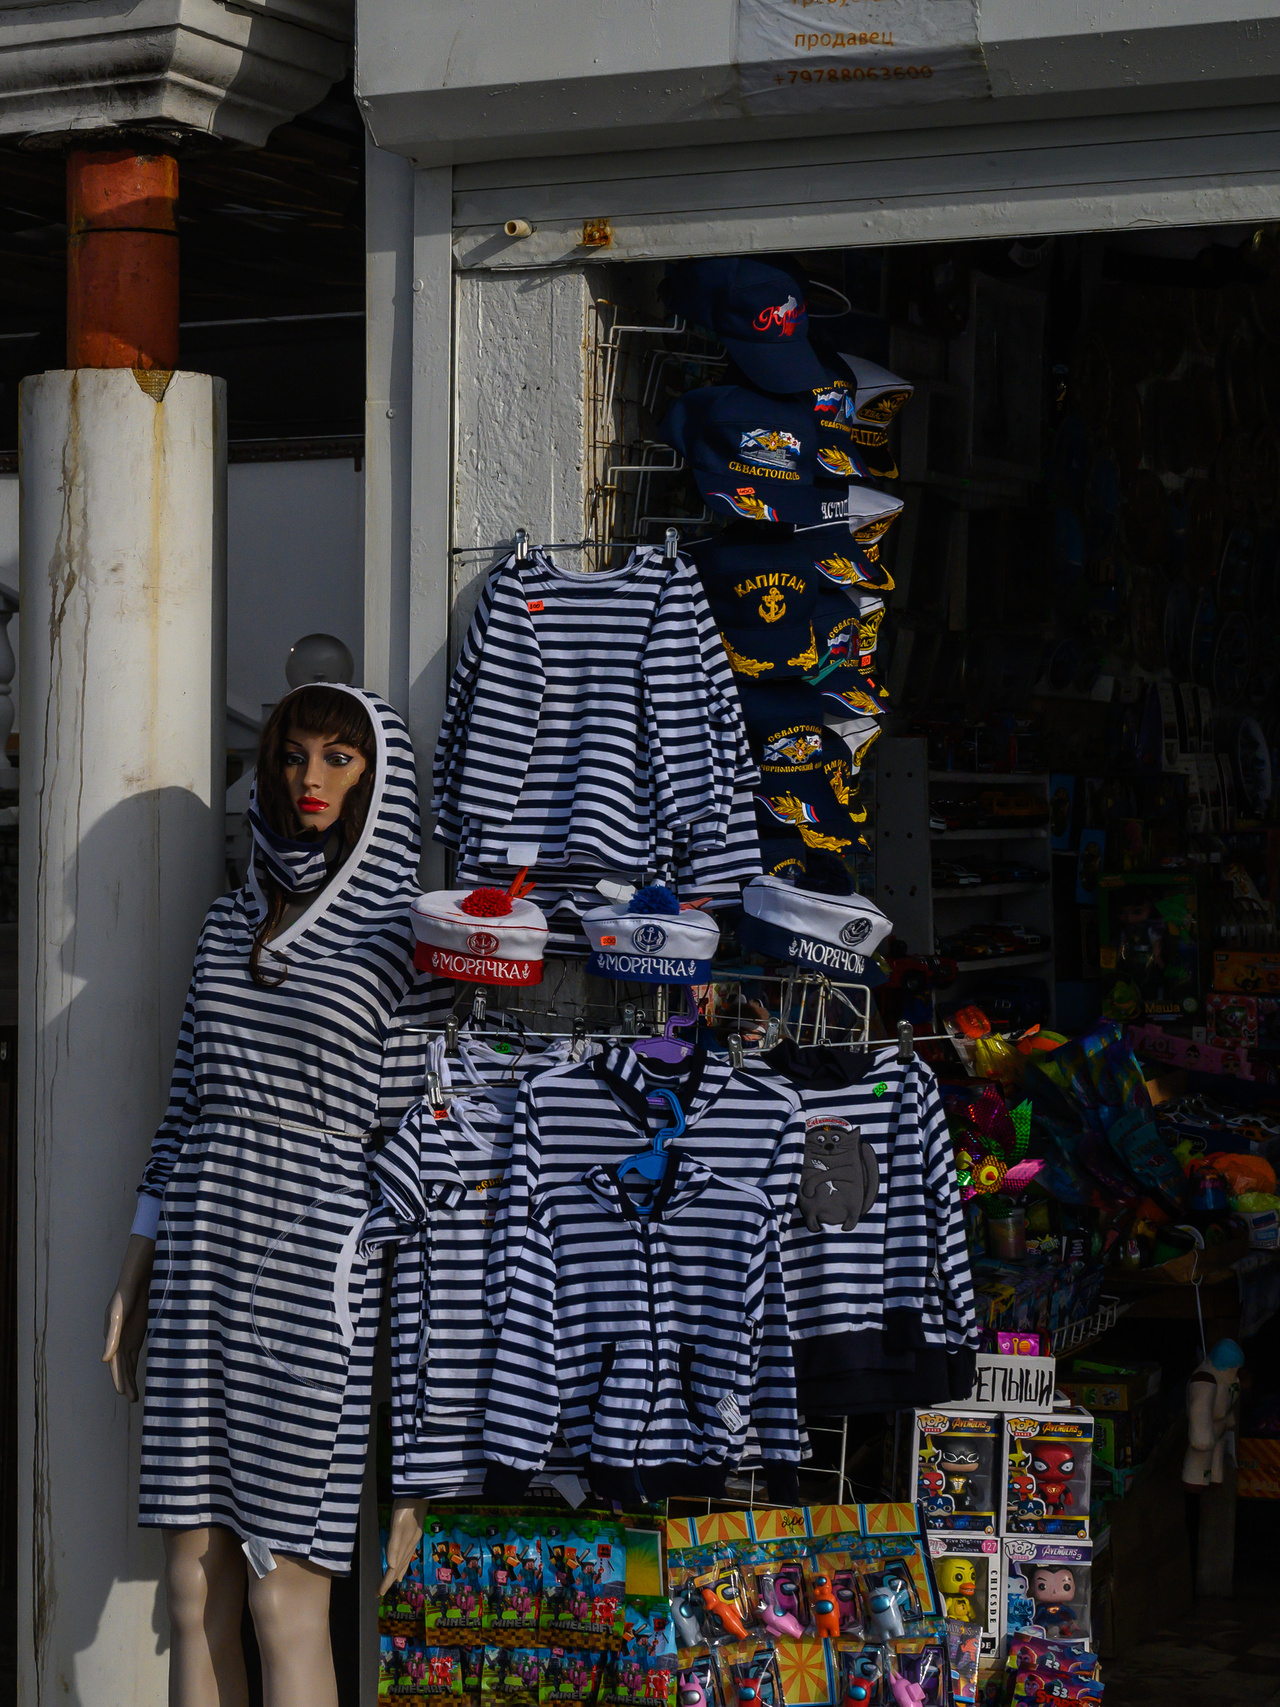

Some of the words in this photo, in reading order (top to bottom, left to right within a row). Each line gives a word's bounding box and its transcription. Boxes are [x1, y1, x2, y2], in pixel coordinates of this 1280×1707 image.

[794, 30, 894, 50] продавец
[728, 460, 800, 480] СЕВАСТОПОЛЬ
[733, 572, 806, 598] КАПИТАН
[798, 939, 863, 975] МОРЯЧОК
[439, 952, 522, 980] МОРЯЧКА
[605, 955, 688, 977] МОРЯЧКА
[1144, 1003, 1181, 1014] Маша
[918, 1414, 949, 1428] POP!
[1008, 1418, 1039, 1432] POP!
[982, 1542, 998, 1551] 127
[1006, 1541, 1037, 1555] POP!
[548, 1618, 614, 1635] MINECRAFT
[388, 1684, 453, 1696] MINECRAFT
